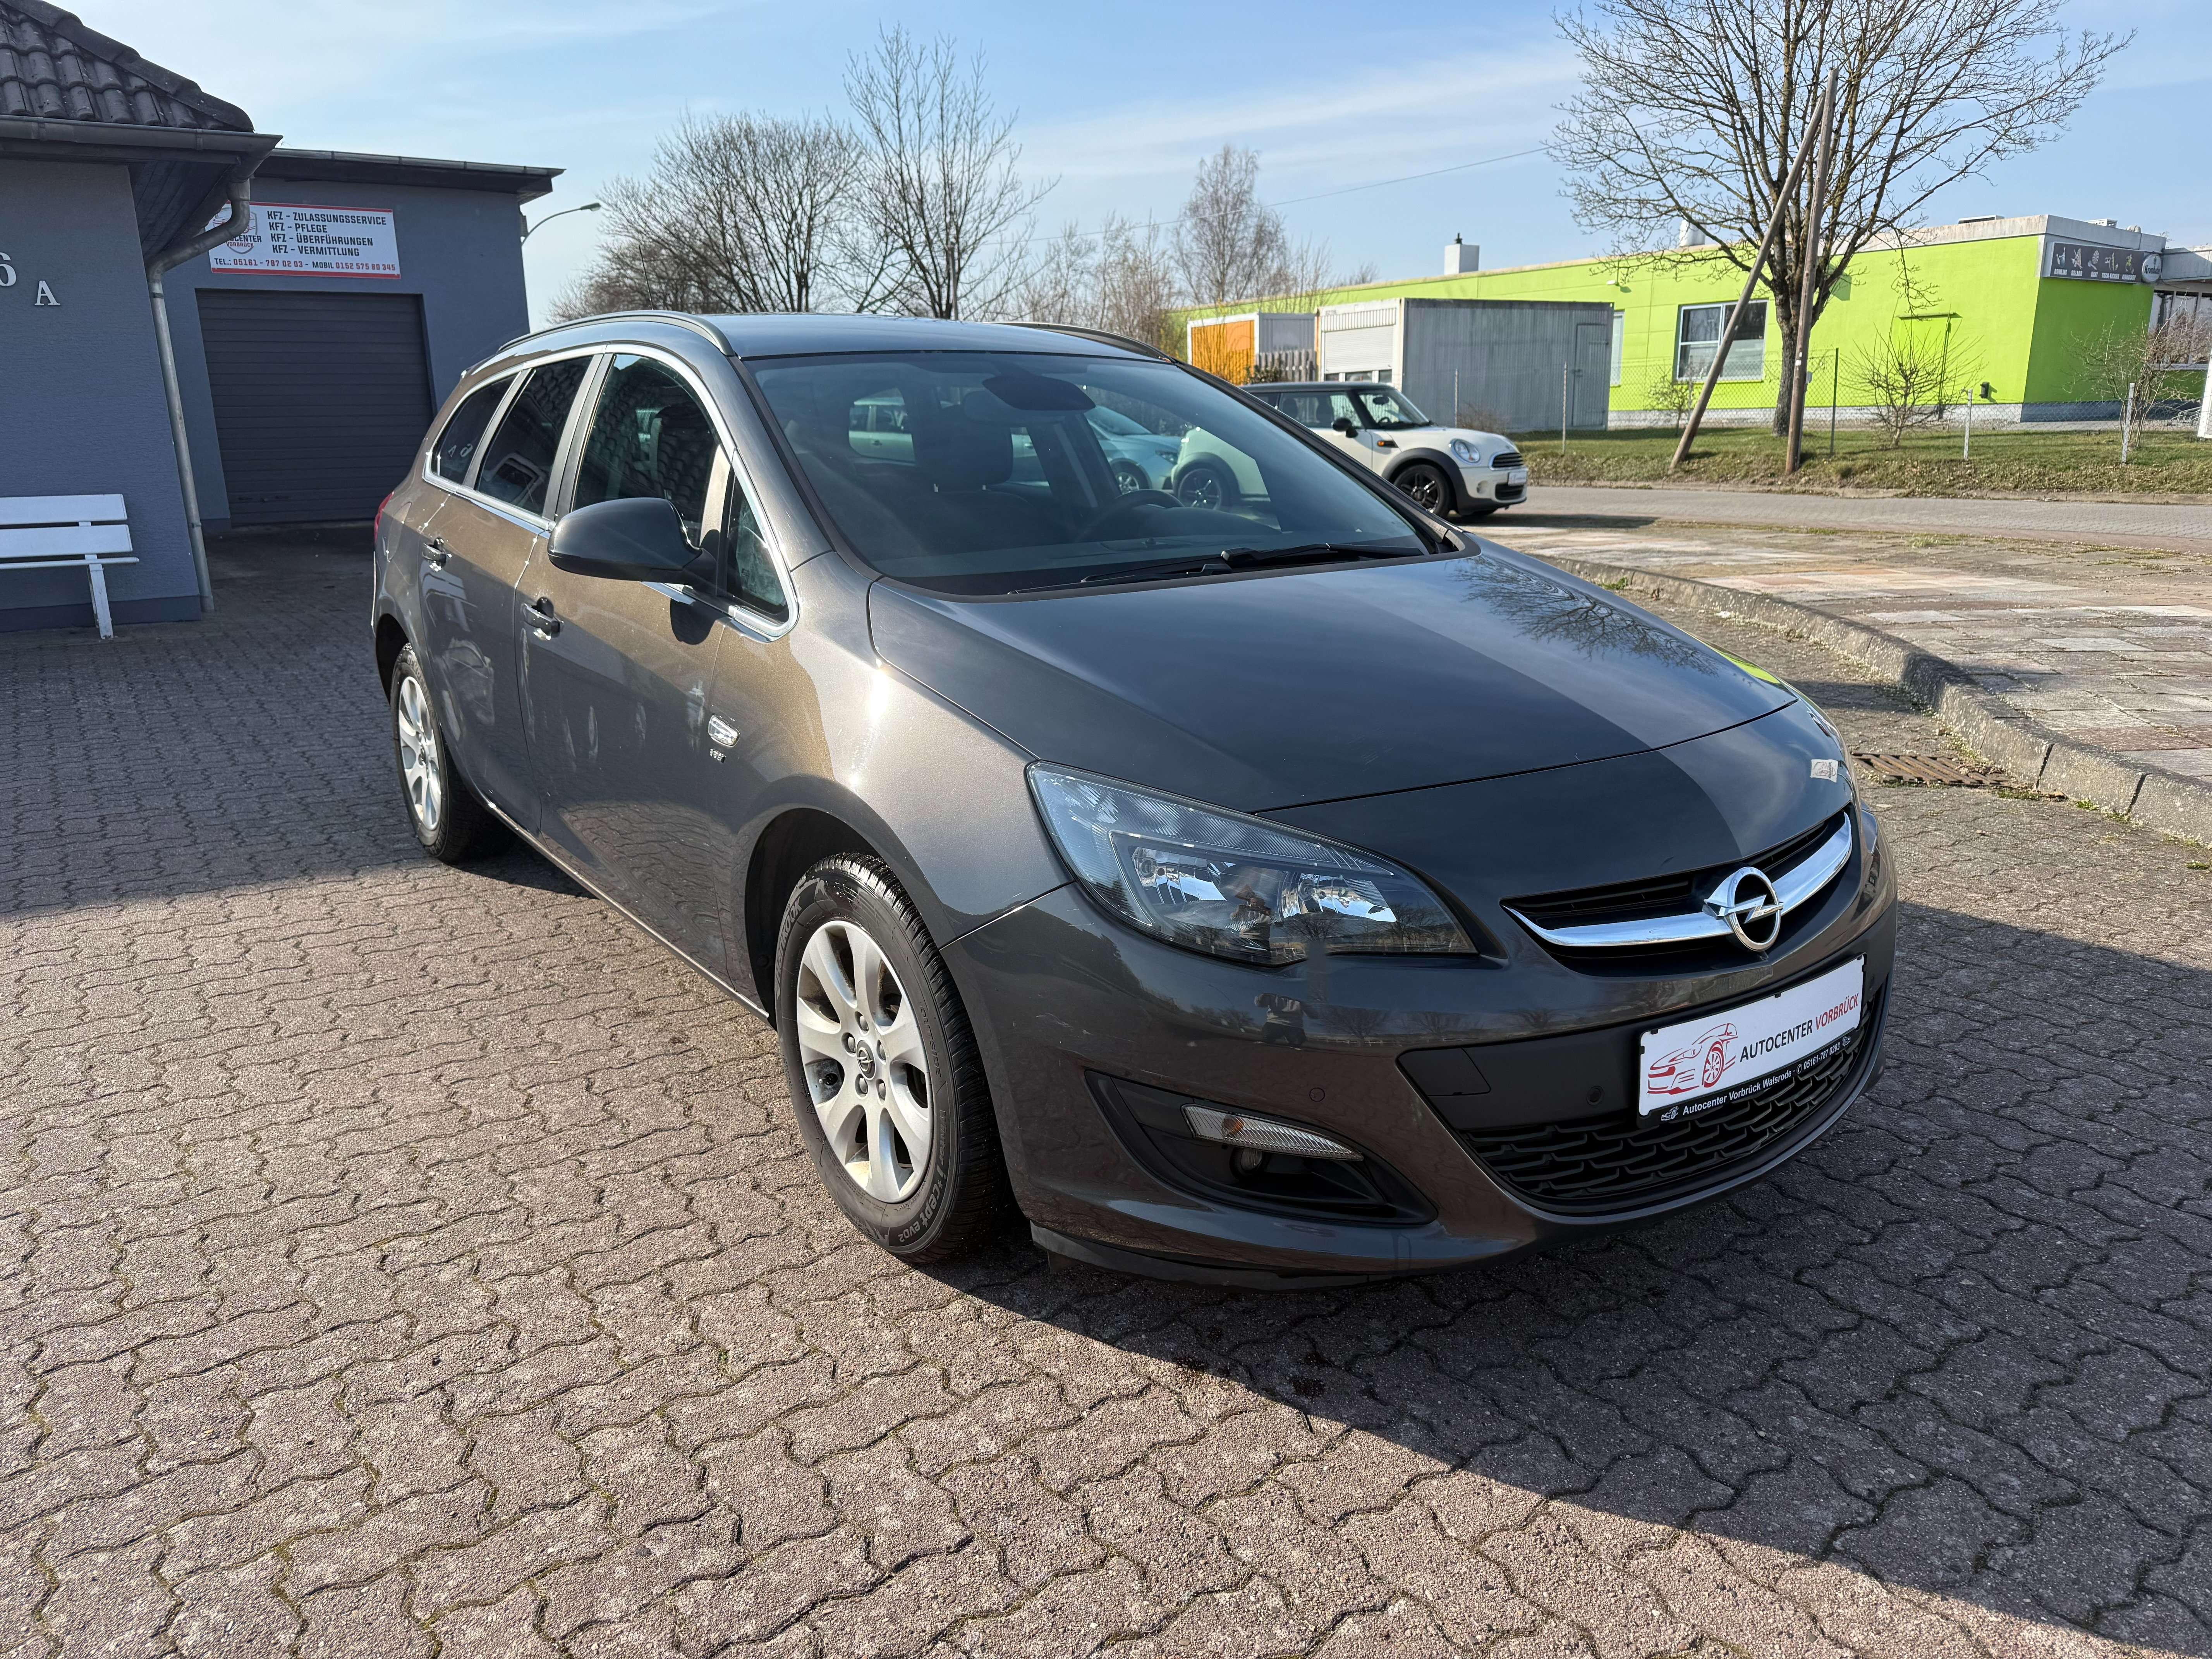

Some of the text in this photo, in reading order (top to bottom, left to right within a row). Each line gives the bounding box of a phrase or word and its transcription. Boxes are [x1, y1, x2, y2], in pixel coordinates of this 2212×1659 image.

[267, 211, 283, 220] KFZ
[293, 212, 386, 225] ZULASSUNGSSERVICE
[269, 222, 285, 231] KFZ
[295, 223, 328, 233] PFLEGE
[271, 233, 287, 242] KFZ
[296, 233, 373, 246] ÜBERFÜHRUNGEN
[272, 244, 289, 253] KFZ
[297, 245, 359, 256] VERMITTLUNG
[0, 252, 60, 305] 6 A
[1740, 993, 1858, 1062] AUTOCENTER VORBRÜCK
[1683, 1042, 1840, 1115] Autocenter Vorbrück Walsrode 05161-787 0203
